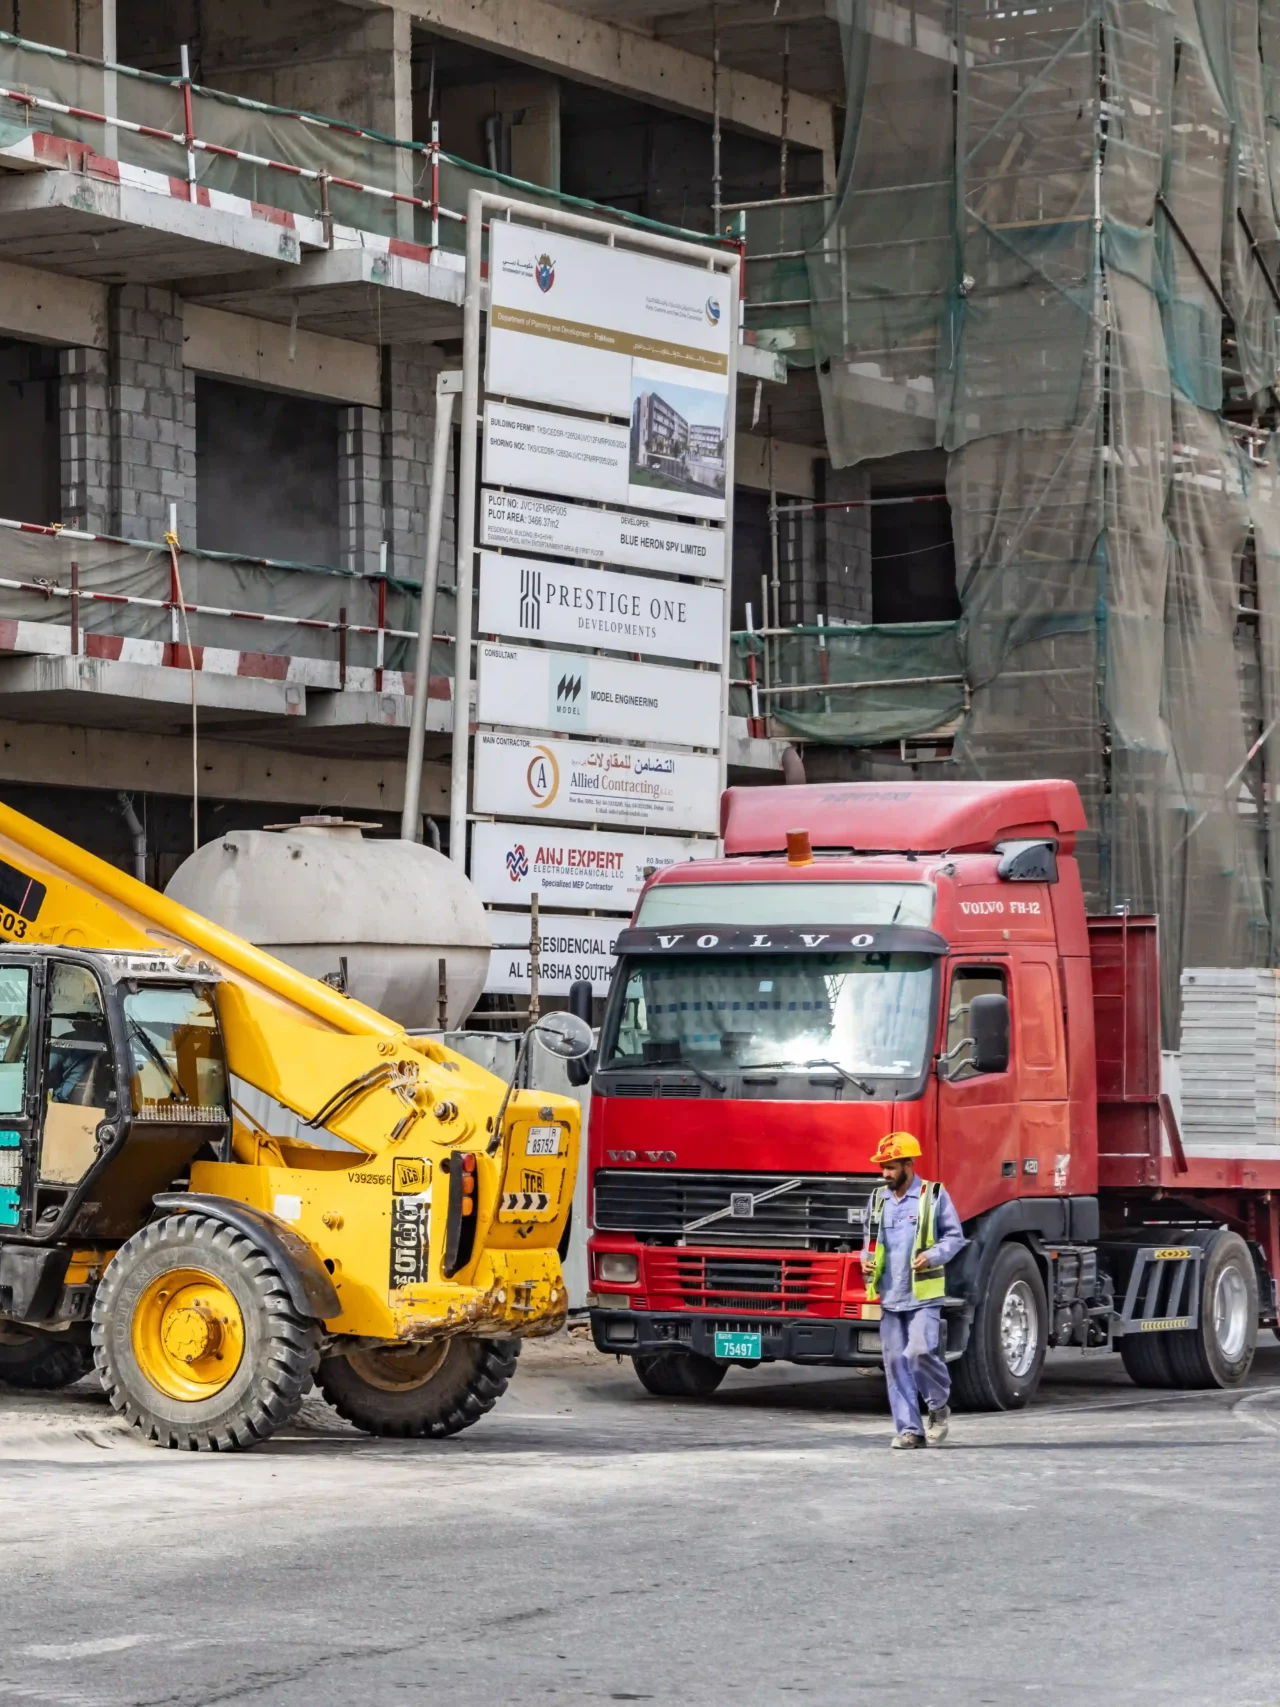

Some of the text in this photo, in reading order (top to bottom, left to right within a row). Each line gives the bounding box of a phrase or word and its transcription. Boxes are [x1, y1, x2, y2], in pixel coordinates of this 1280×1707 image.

[497, 312, 525, 325] Department
[531, 319, 552, 332] Planning
[552, 324, 561, 332] and
[561, 325, 590, 339] Development
[489, 437, 513, 448] SHORING
[513, 442, 527, 451] NOC:
[488, 495, 567, 517] PLOT NO: JVC12FMRP005
[488, 509, 505, 520] PLOT
[506, 512, 526, 524] AREA:
[620, 516, 651, 528] DEVELOPER:
[514, 529, 533, 538] BUILDING
[508, 536, 521, 545] POOL
[521, 538, 531, 546] WITH
[563, 544, 575, 552] AREA
[579, 547, 591, 555] FIRST
[591, 548, 605, 557] FLOOR
[620, 534, 707, 557] BLUE HERON SPV LIMITED
[545, 583, 687, 623] PRESTIGE ONE
[578, 617, 657, 638] DEVELOPMENTS
[484, 648, 518, 660] CONSULTANT:
[590, 690, 659, 708] MODEL ENGINEERING
[556, 705, 581, 716] MODEL
[482, 735, 531, 748] MAIN CONTRACTOR:
[587, 753, 631, 772] للمقاولات
[634, 757, 675, 775] التضامن
[536, 763, 547, 788] A
[570, 772, 599, 789] Allied
[601, 776, 660, 799] Contracting
[534, 846, 624, 870] ANJ EXPERT
[533, 866, 624, 879] ELECTROMECHANICAL LLC
[541, 878, 613, 891] Specialized MEP Contractor
[958, 901, 1041, 915] VOLVO FH-12
[656, 933, 874, 949] VOLVO
[509, 962, 523, 978] AL
[574, 964, 612, 982] SOUTH
[551, 1128, 557, 1138] R
[532, 1138, 554, 1154] 85752
[1024, 1160, 1038, 1173] 420
[401, 1166, 419, 1185] JCB
[523, 1173, 543, 1193] JCB
[723, 1342, 753, 1356] 75497
